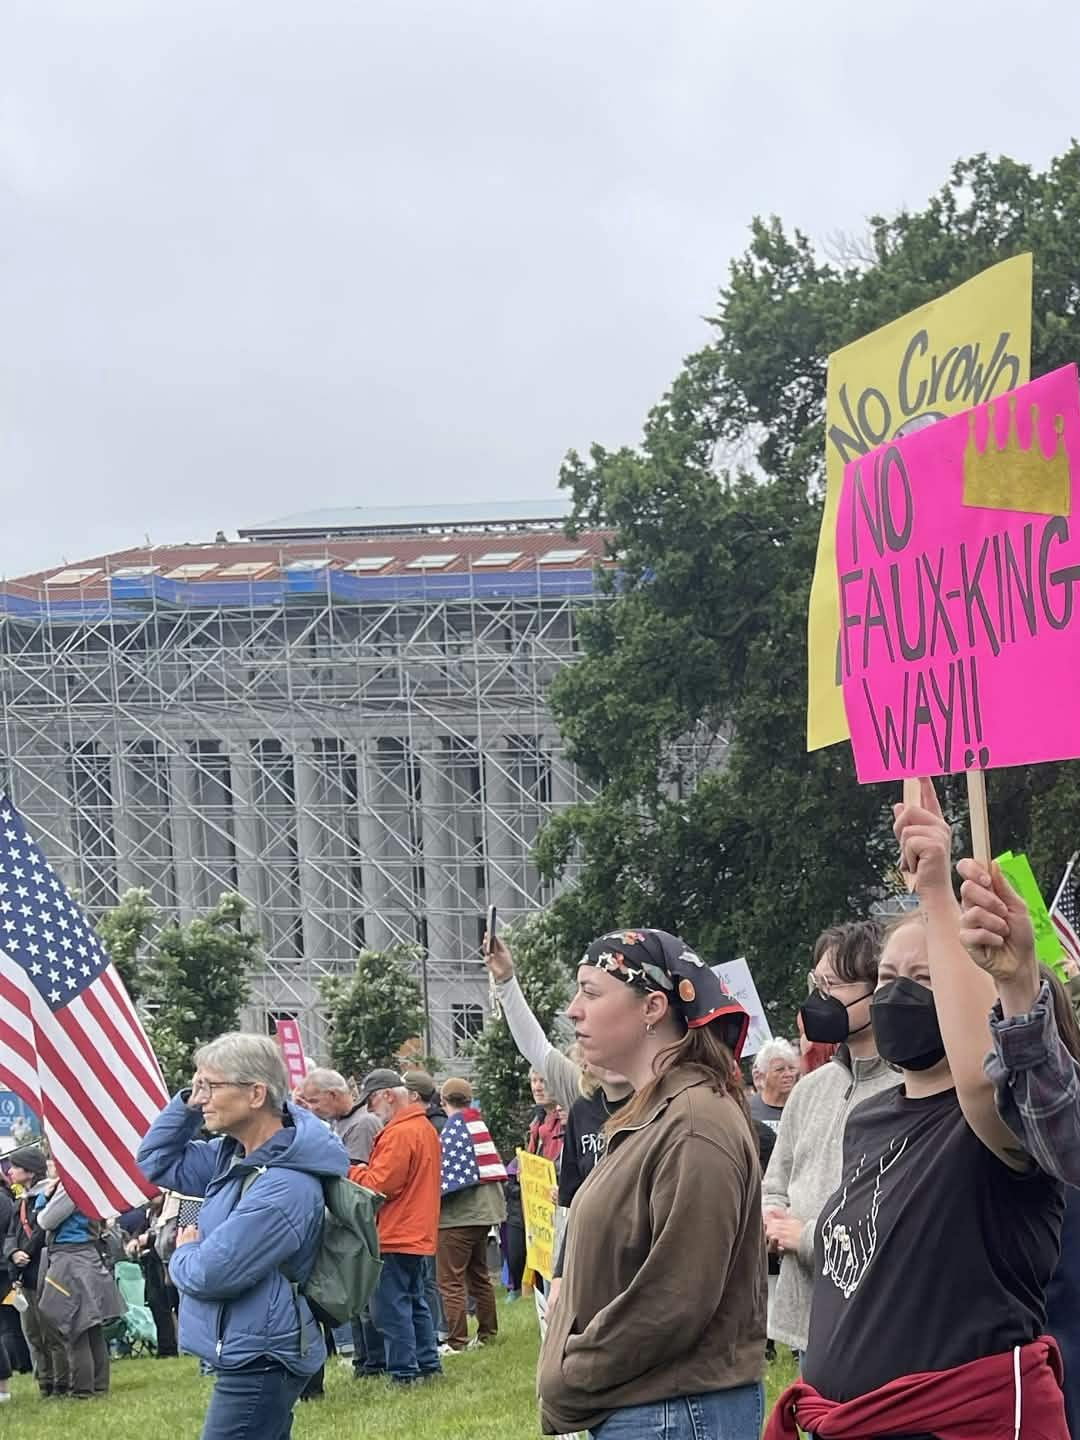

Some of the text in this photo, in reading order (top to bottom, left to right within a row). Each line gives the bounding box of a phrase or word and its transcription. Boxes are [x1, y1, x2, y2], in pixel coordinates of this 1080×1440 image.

[898, 329, 1021, 417] Crown
[853, 446, 913, 565] NO
[862, 655, 990, 772] WAY!!
